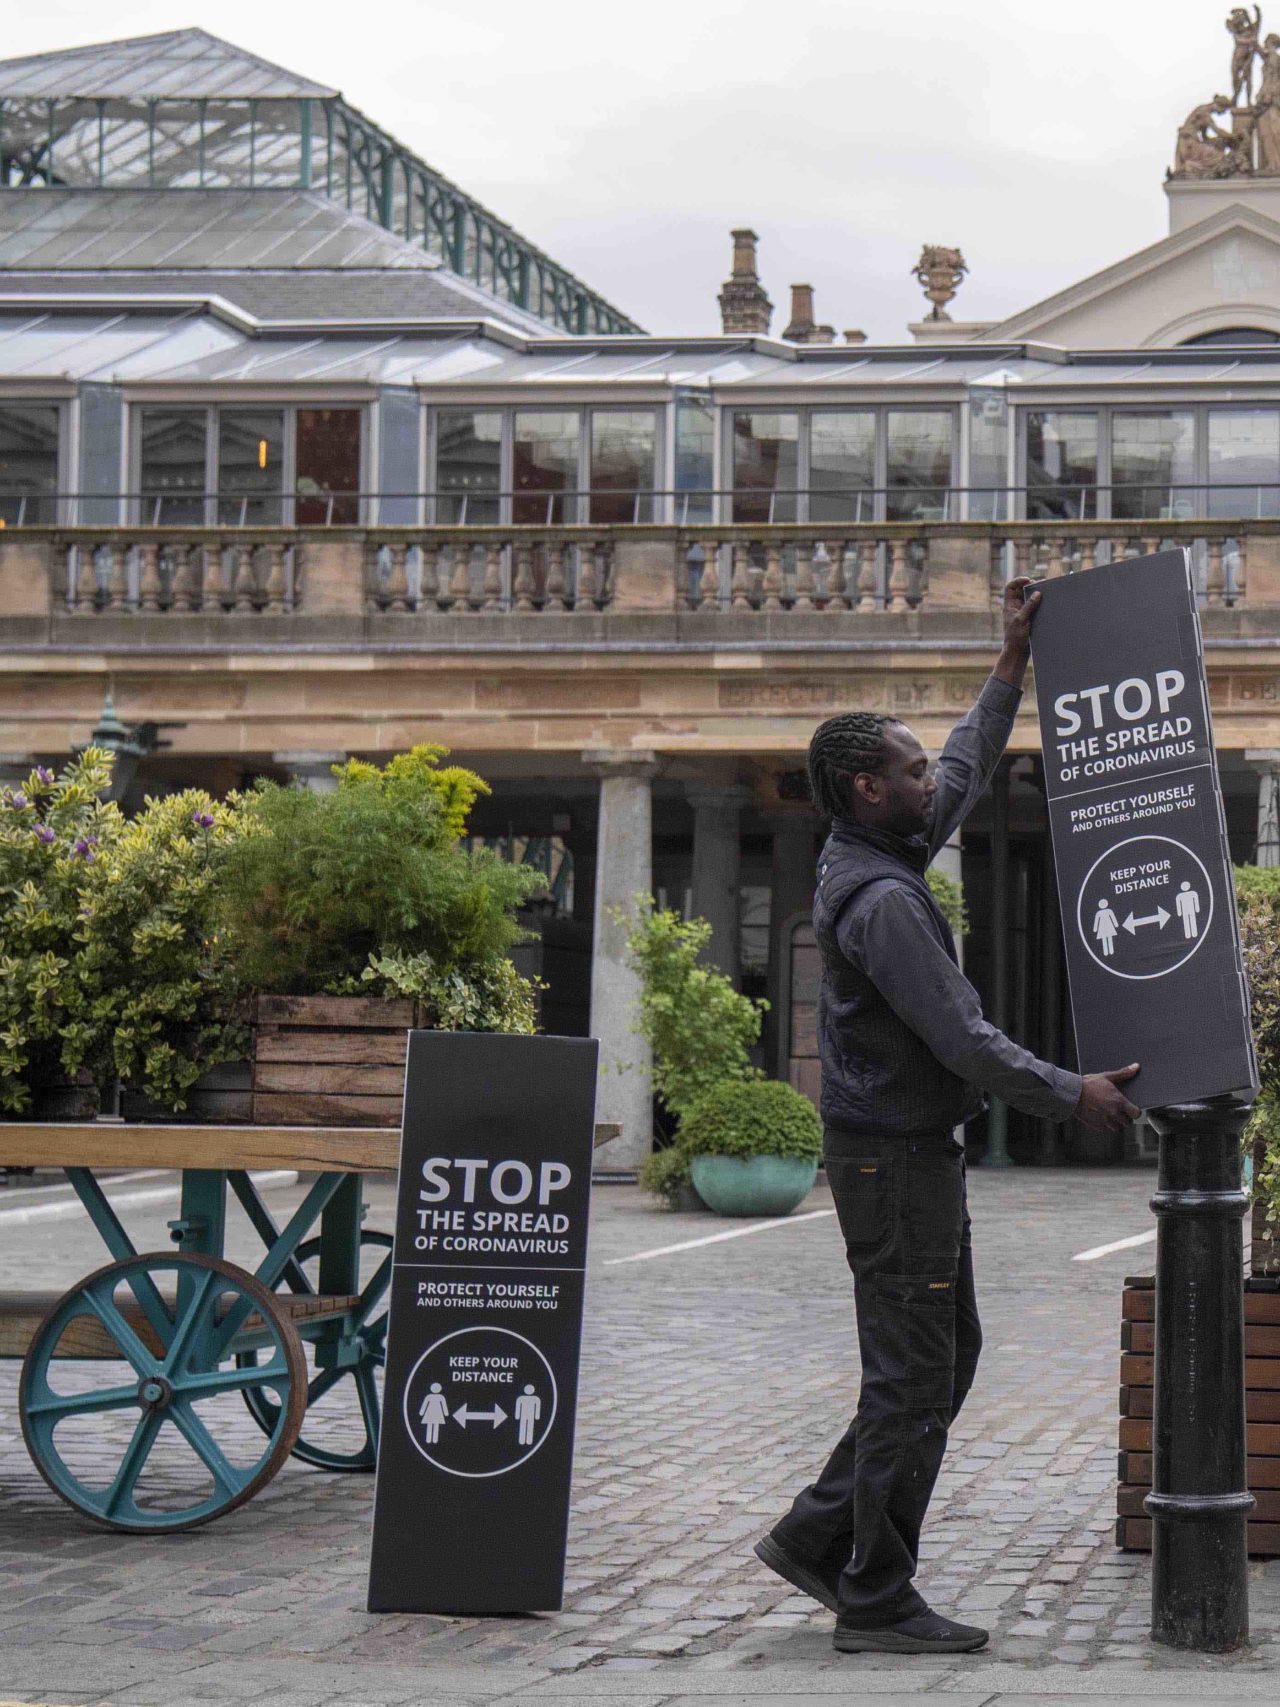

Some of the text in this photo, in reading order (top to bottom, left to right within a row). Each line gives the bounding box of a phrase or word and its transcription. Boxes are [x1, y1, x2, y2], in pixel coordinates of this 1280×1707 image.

[1054, 669, 1185, 736] STOP
[1057, 716, 1192, 763] THE SPREAD
[1060, 741, 1195, 781] OF CORONAVIRUS
[1070, 785, 1195, 821] PROTECT YOURSELF
[1072, 799, 1196, 833] AND OTHERS AROUND YOU
[1110, 860, 1171, 881] KEEP YOUR
[1114, 874, 1169, 894] DISTANCE
[420, 1158, 571, 1205] STOP
[417, 1210, 569, 1233] THE SPREAD
[415, 1236, 568, 1253] OF CORONAVIRUS
[418, 1283, 559, 1297] PROTECT YOURSELF
[417, 1298, 557, 1309] AND OTHERS AROUND YOU
[450, 1357, 518, 1368] KEEP YOUR
[453, 1372, 513, 1382] DISTANCE
